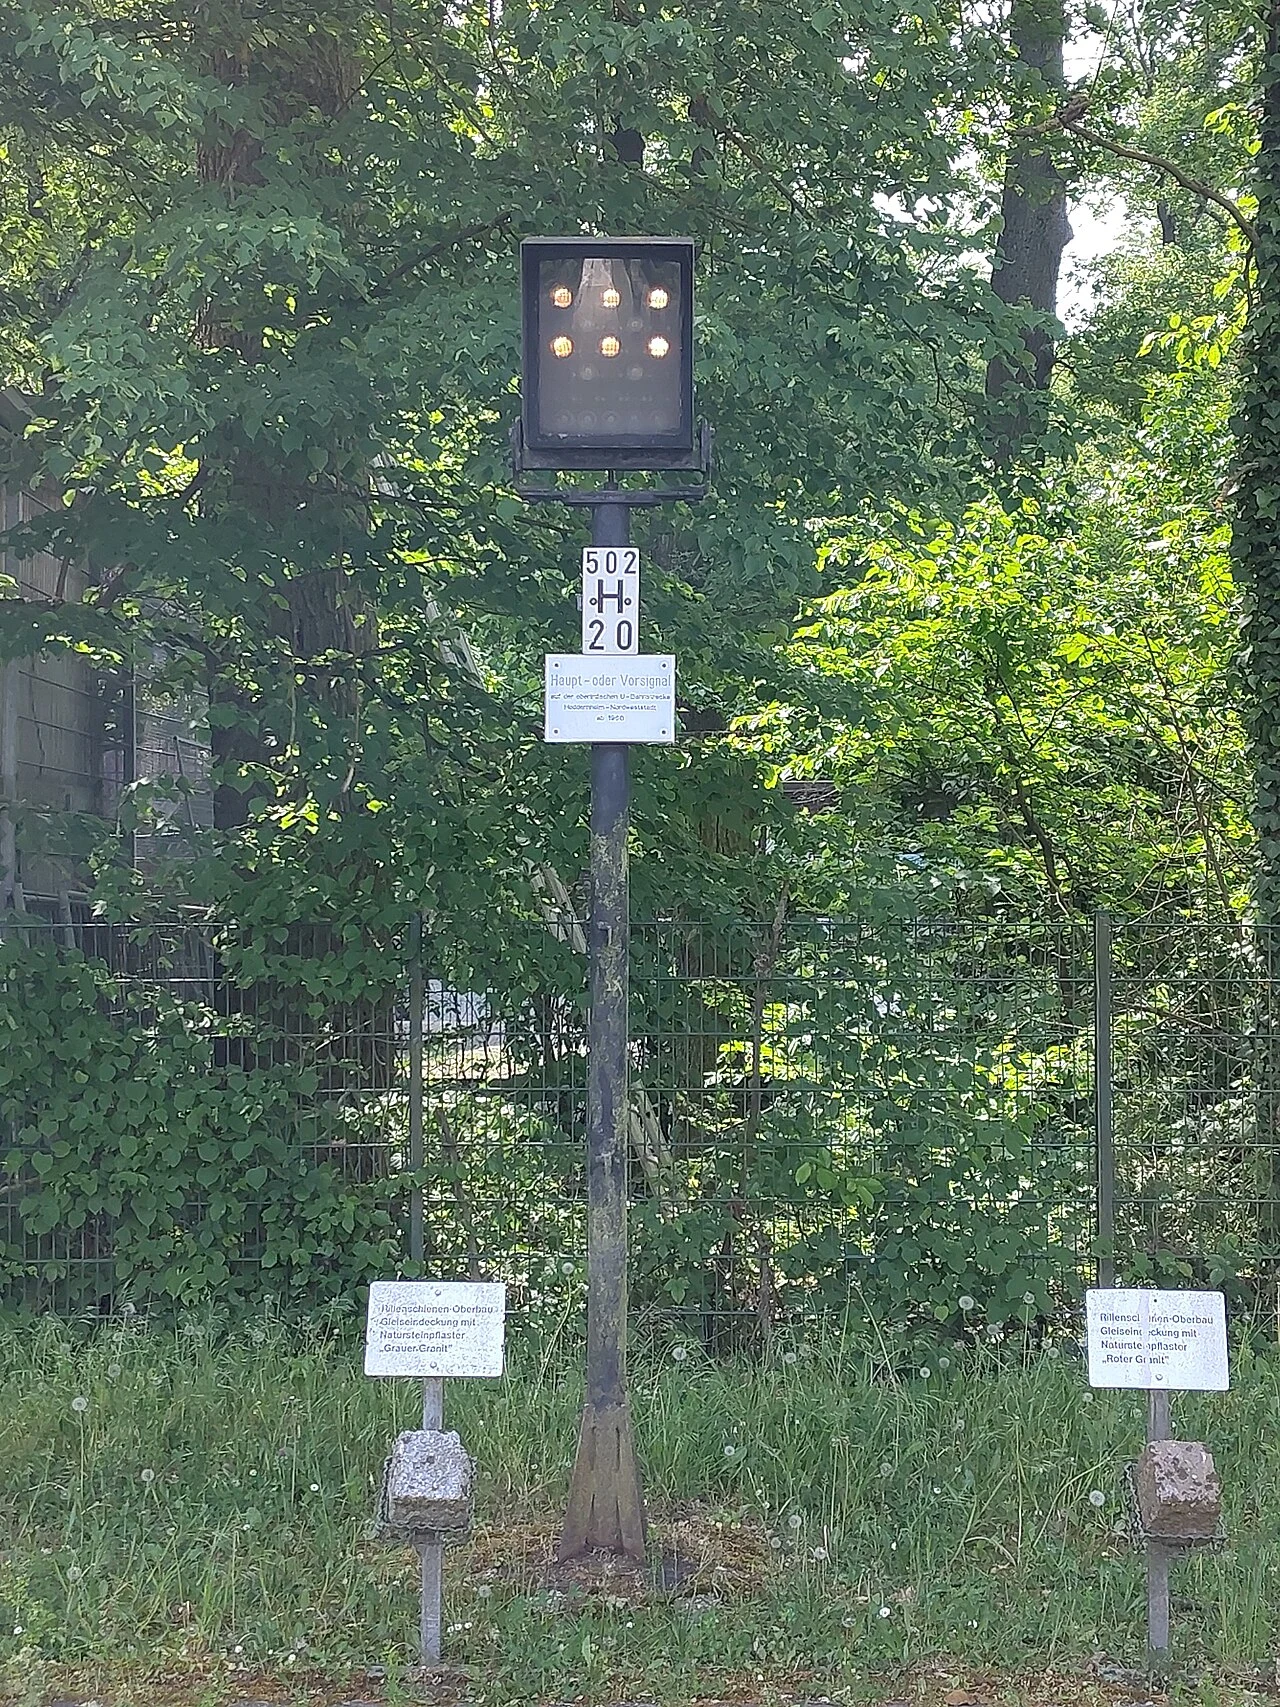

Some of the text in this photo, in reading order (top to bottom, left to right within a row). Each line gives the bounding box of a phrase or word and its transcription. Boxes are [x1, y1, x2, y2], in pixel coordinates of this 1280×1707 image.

[586, 551, 637, 574] 502
[597, 579, 624, 613] H
[588, 619, 633, 651] 20
[619, 674, 671, 690] Vorsignal
[460, 1317, 477, 1327] mit
[379, 1330, 466, 1341] Natursteinpflaster
[1181, 1328, 1198, 1338] mit
